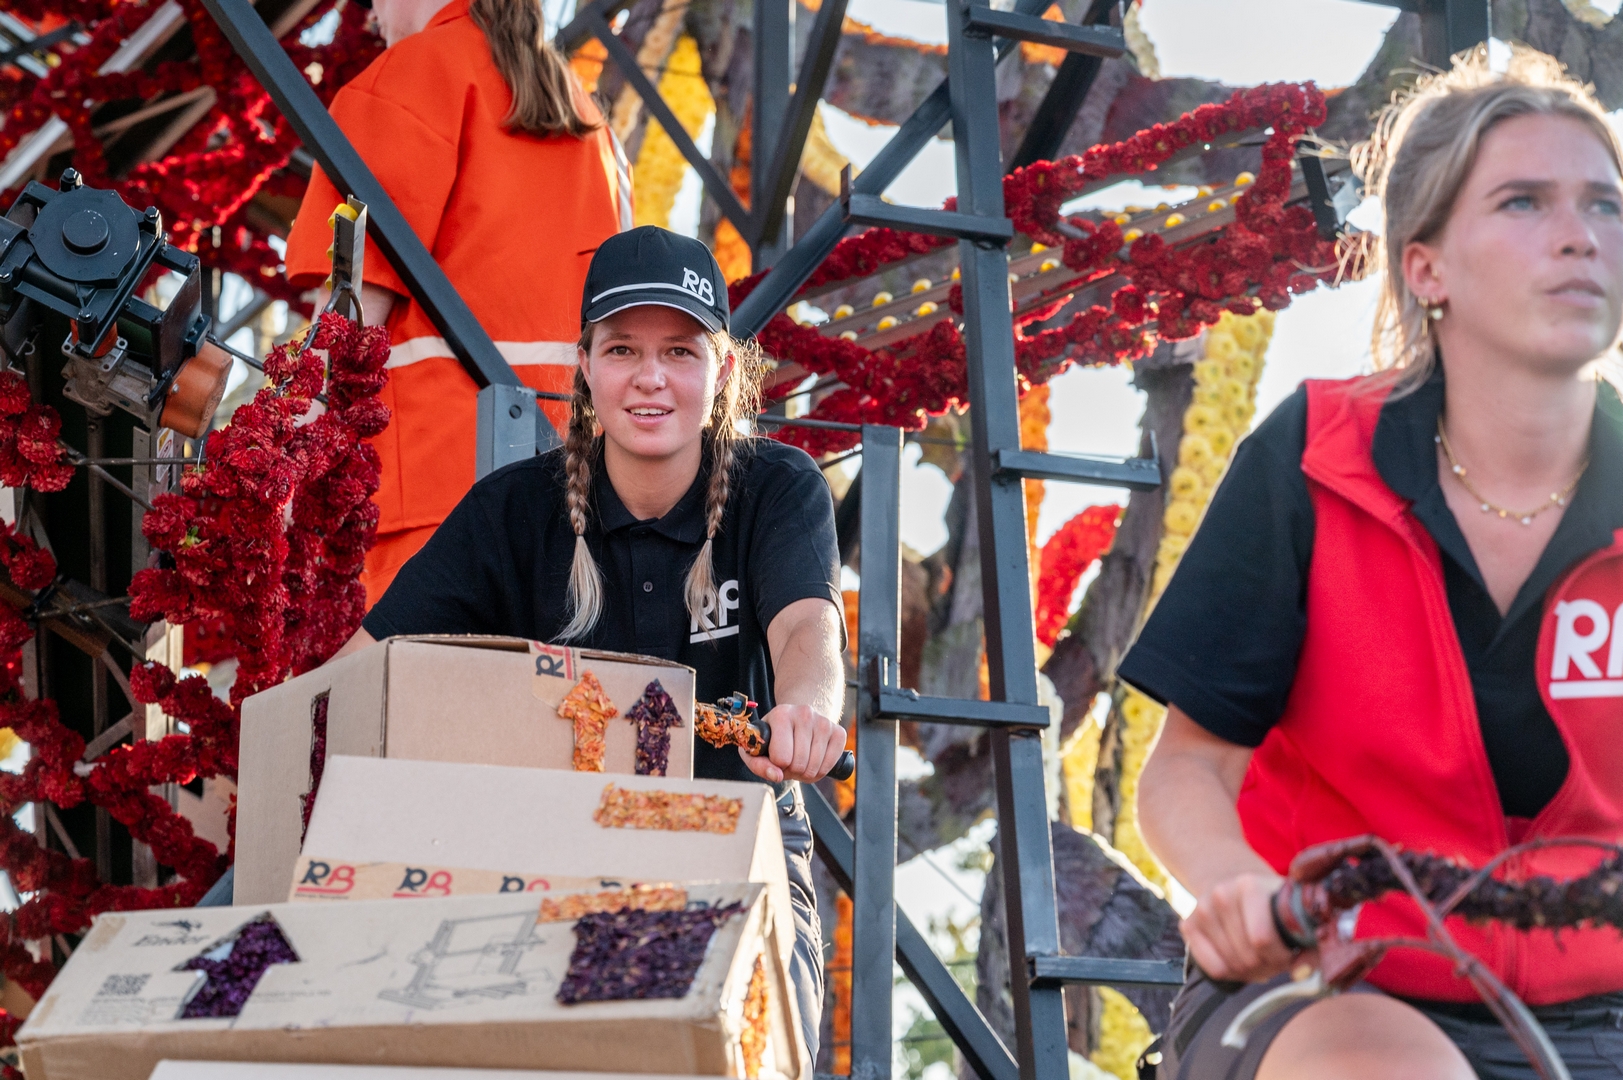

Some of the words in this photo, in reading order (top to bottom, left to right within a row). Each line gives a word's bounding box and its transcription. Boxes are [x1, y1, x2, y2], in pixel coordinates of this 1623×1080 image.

[682, 267, 715, 307] RB
[1549, 598, 1623, 699] R
[296, 860, 355, 895] RB
